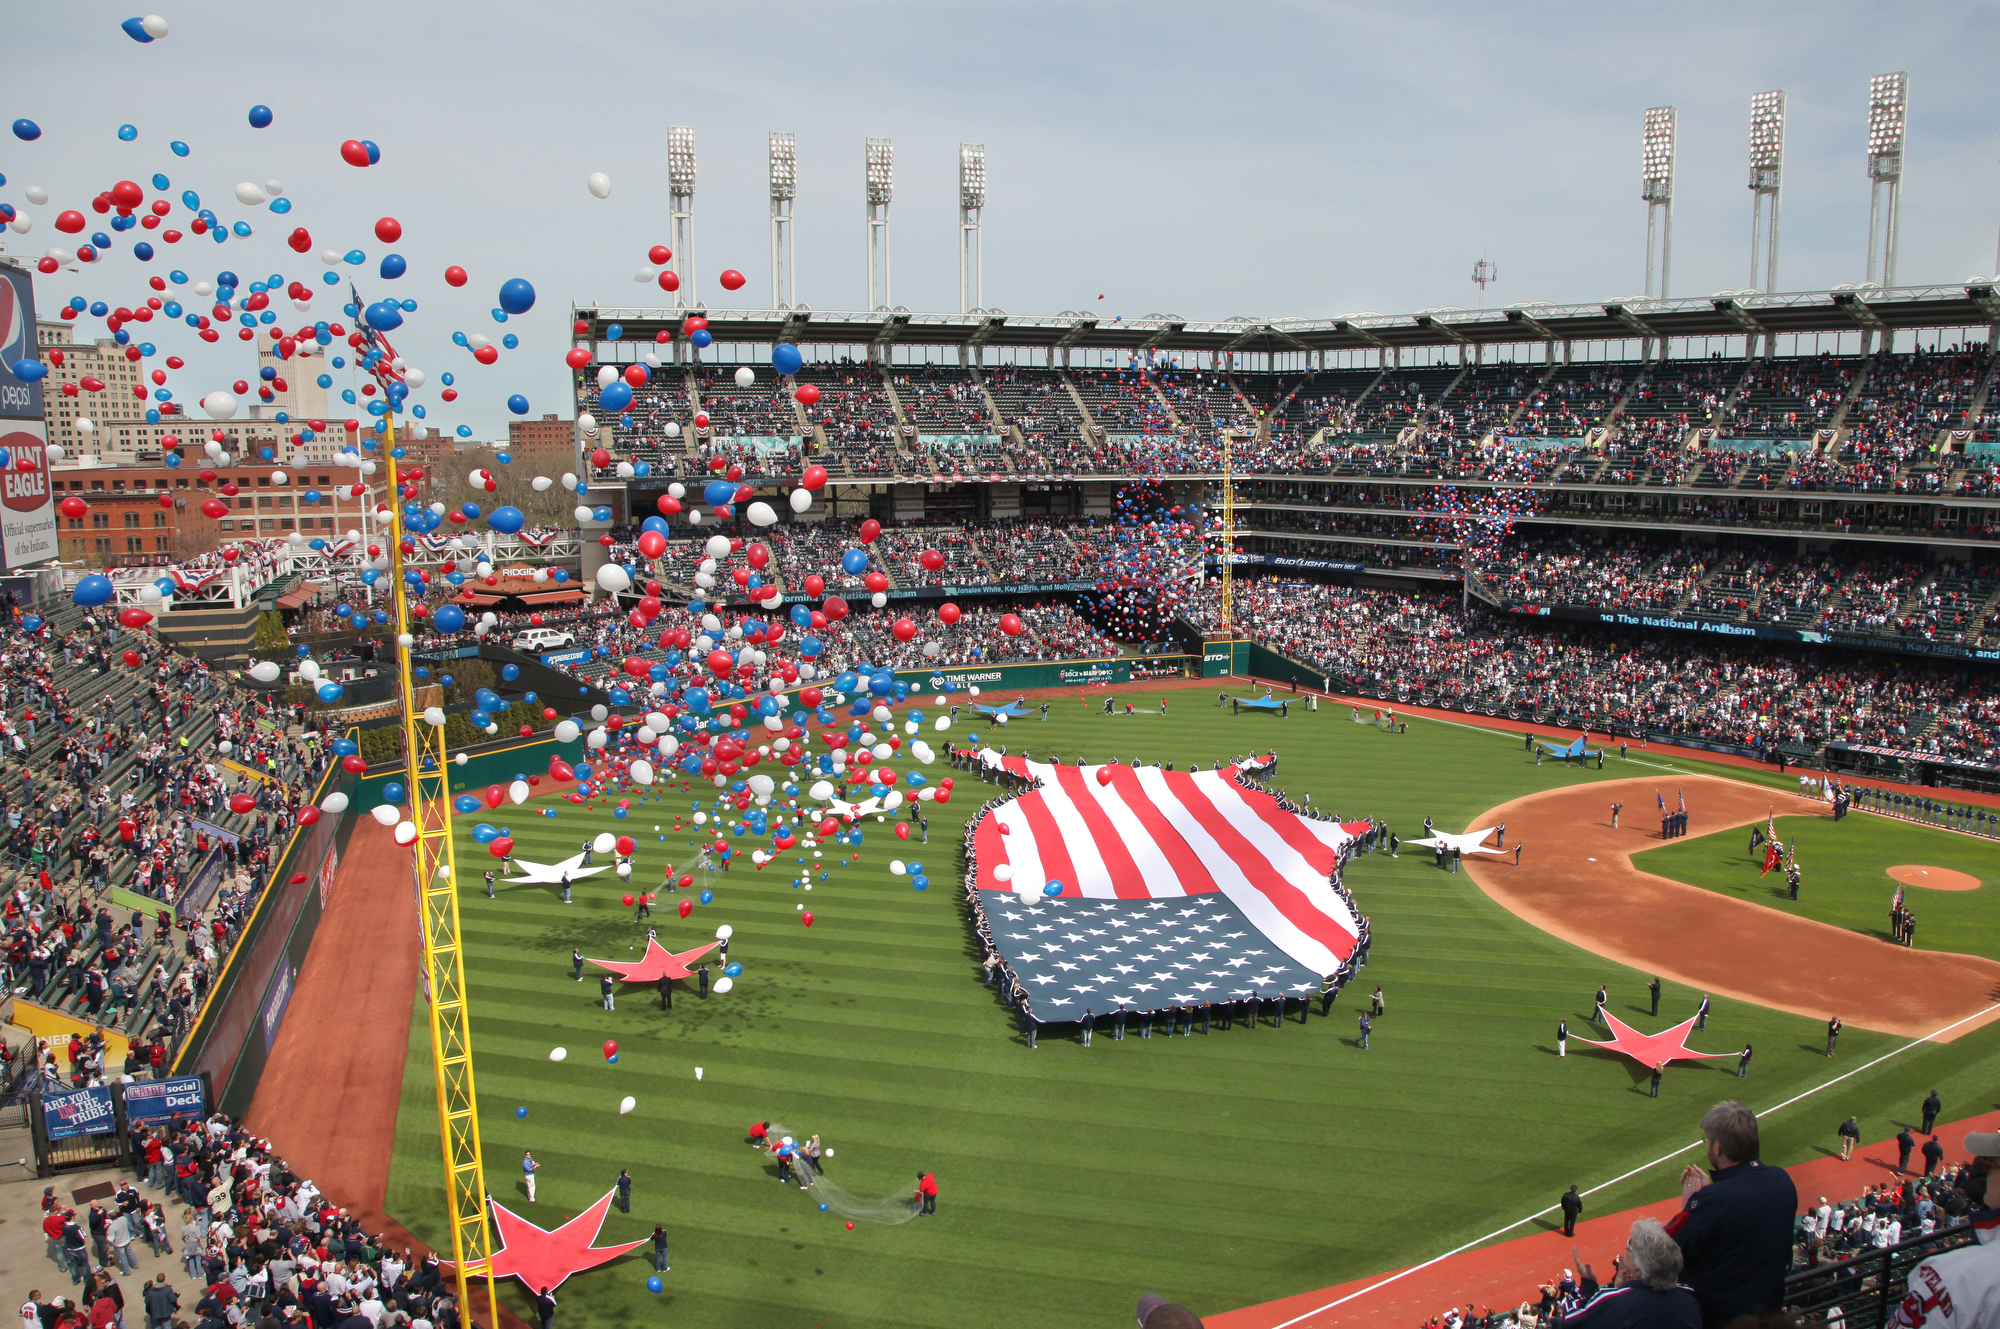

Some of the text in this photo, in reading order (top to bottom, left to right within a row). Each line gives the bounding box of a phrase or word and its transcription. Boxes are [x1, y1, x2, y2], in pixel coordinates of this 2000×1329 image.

[2, 383, 31, 410] pepsi
[6, 472, 45, 498] EAGLE
[4, 518, 54, 538] Official supermarket
[15, 544, 21, 555] of
[22, 541, 30, 554] the
[1274, 557, 1296, 566] BUD
[1299, 558, 1328, 568] LIGHT
[502, 568, 536, 576] RIDGID
[838, 590, 874, 600] National
[885, 590, 916, 599] Anthem
[983, 585, 1004, 594] White,
[1005, 585, 1017, 594] Kay
[1018, 584, 1039, 592] Harris,
[1054, 583, 1070, 592] Molly
[1617, 614, 1638, 624] The
[1642, 616, 1698, 630] National
[1701, 622, 1755, 636] Anthem
[1821, 634, 2000, 660] Jonalee White, Kay Harris, and
[442, 650, 459, 660] PM
[967, 672, 1002, 680] WARNER
[454, 782, 466, 790] 400
[130, 1082, 196, 1098] TRIBE social
[44, 1090, 91, 1112] ARE YOU
[166, 1094, 201, 1107] Deck
[57, 1096, 100, 1119] IN THE
[69, 1100, 114, 1126] TRIBE?
[215, 1192, 226, 1202] 39
[23, 1311, 34, 1320] 48
